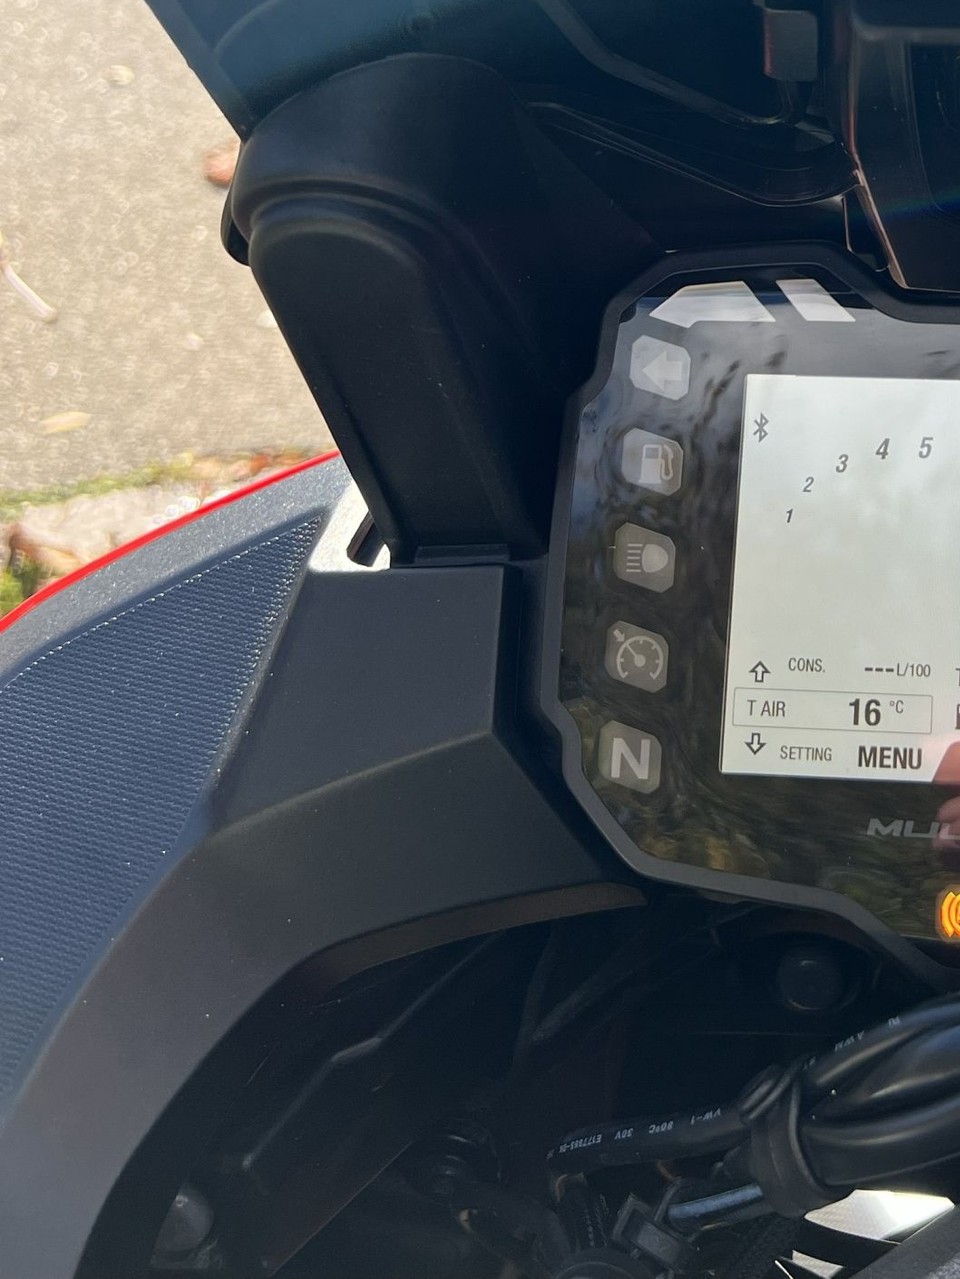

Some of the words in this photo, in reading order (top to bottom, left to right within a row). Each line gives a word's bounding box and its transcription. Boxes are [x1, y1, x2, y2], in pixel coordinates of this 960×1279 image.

[875, 437, 891, 460] 4
[918, 436, 934, 460] 5
[835, 453, 849, 474] 3
[802, 476, 815, 493] 2
[786, 508, 794, 524] 1
[788, 657, 826, 673] CONS.
[746, 699, 757, 716] T
[760, 700, 786, 718] AIR
[848, 698, 882, 727] 16
[610, 736, 651, 780] N
[779, 745, 833, 762] SETTING
[857, 745, 922, 770] MENU
